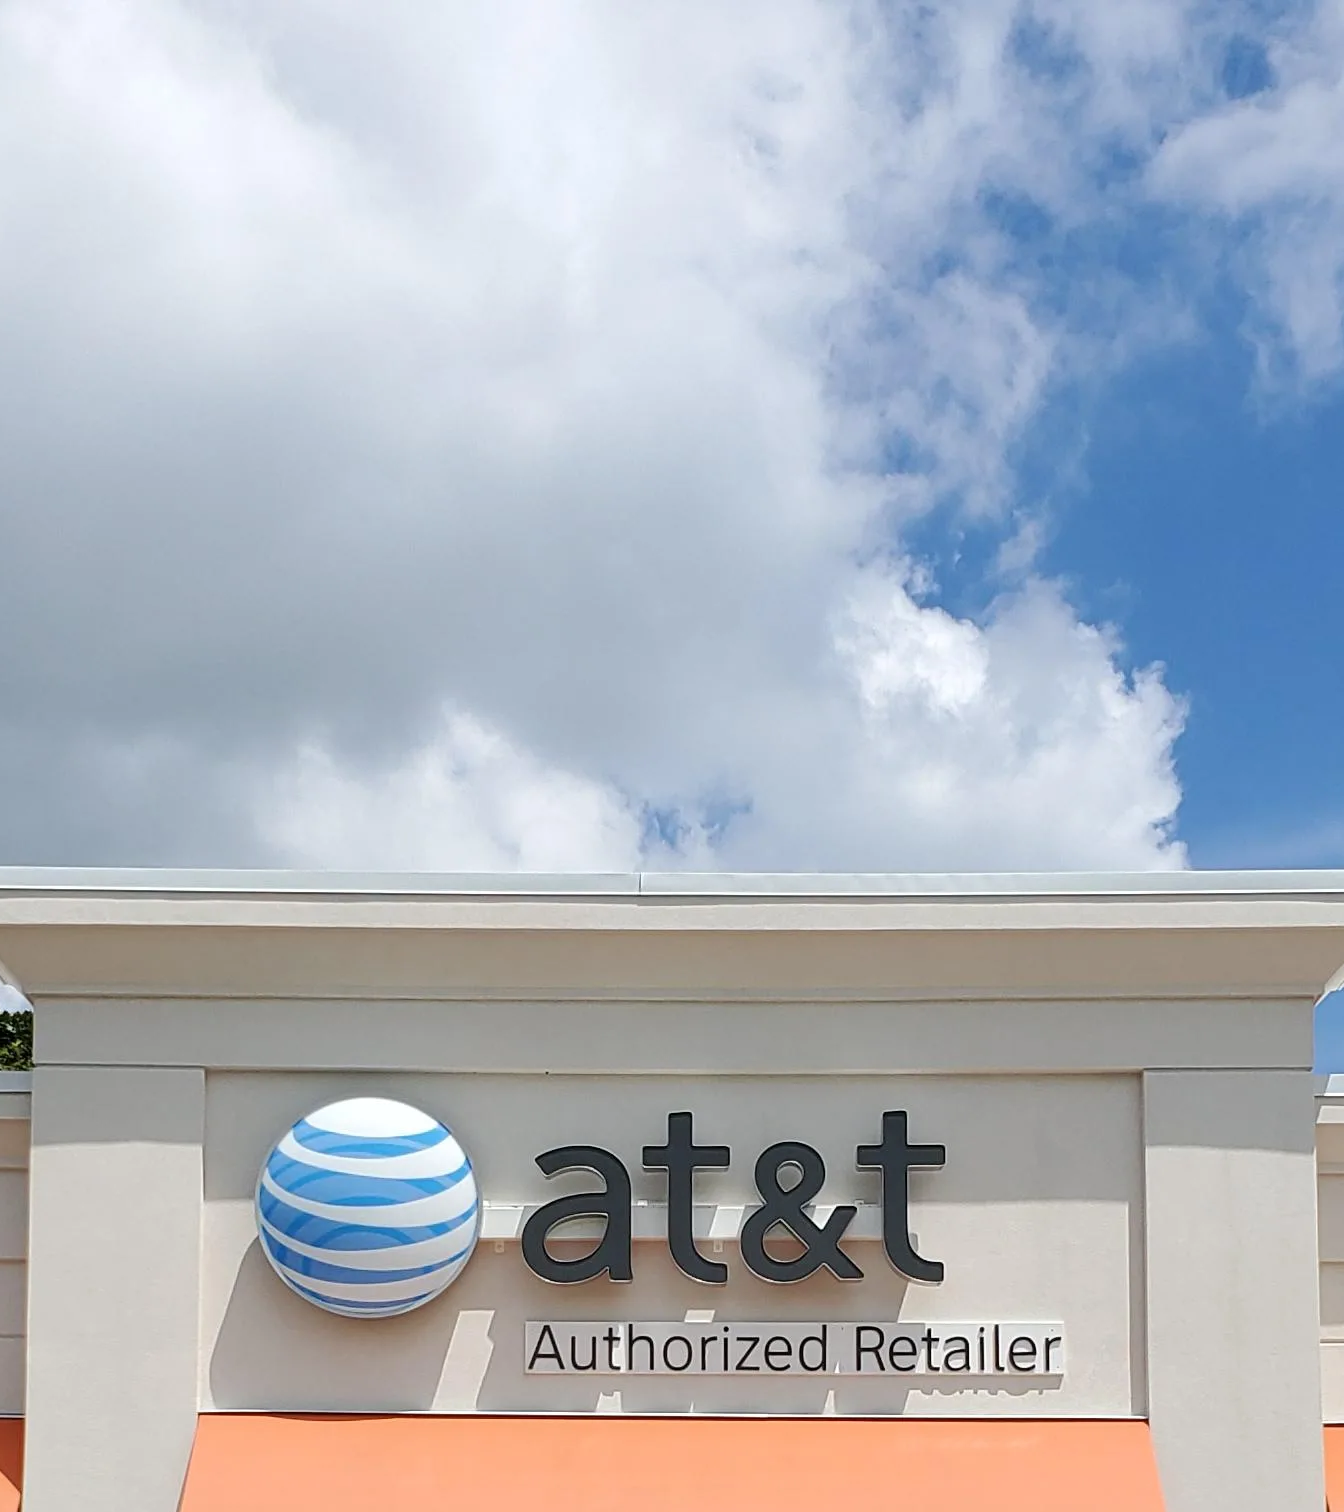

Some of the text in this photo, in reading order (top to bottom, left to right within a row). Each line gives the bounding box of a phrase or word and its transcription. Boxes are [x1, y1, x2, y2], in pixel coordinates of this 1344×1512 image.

[521, 1110, 946, 1286] at&t
[528, 1324, 1062, 1373] Authorized Retailer
